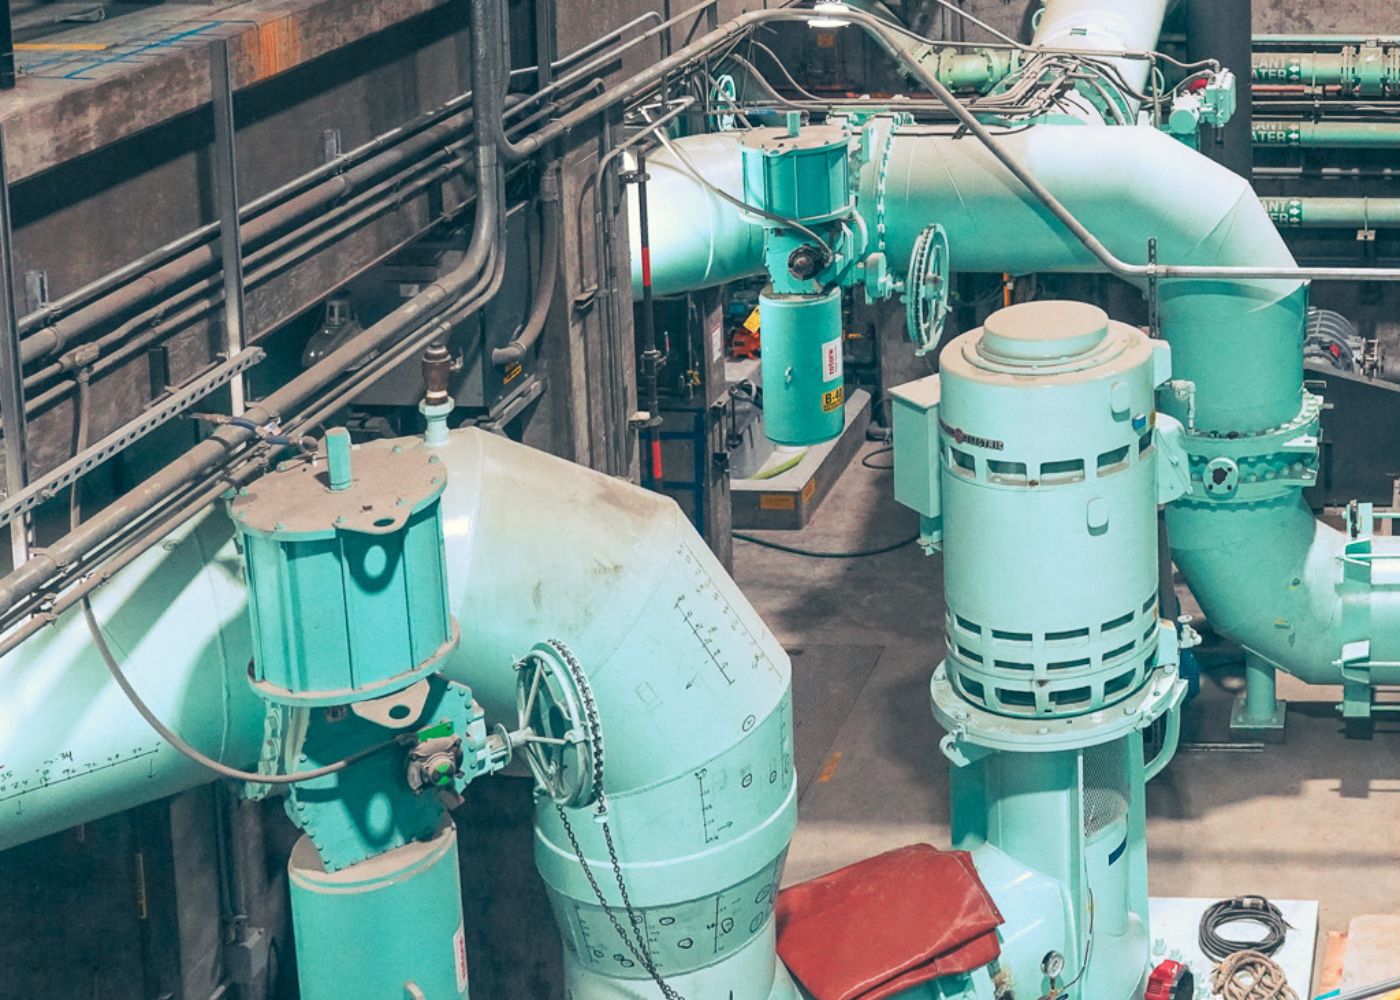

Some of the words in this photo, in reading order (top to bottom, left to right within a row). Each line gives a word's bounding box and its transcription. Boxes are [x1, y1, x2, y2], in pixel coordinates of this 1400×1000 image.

[1251, 57, 1286, 69] LANT
[1251, 69, 1288, 80] ATER
[1251, 131, 1286, 142] ATER
